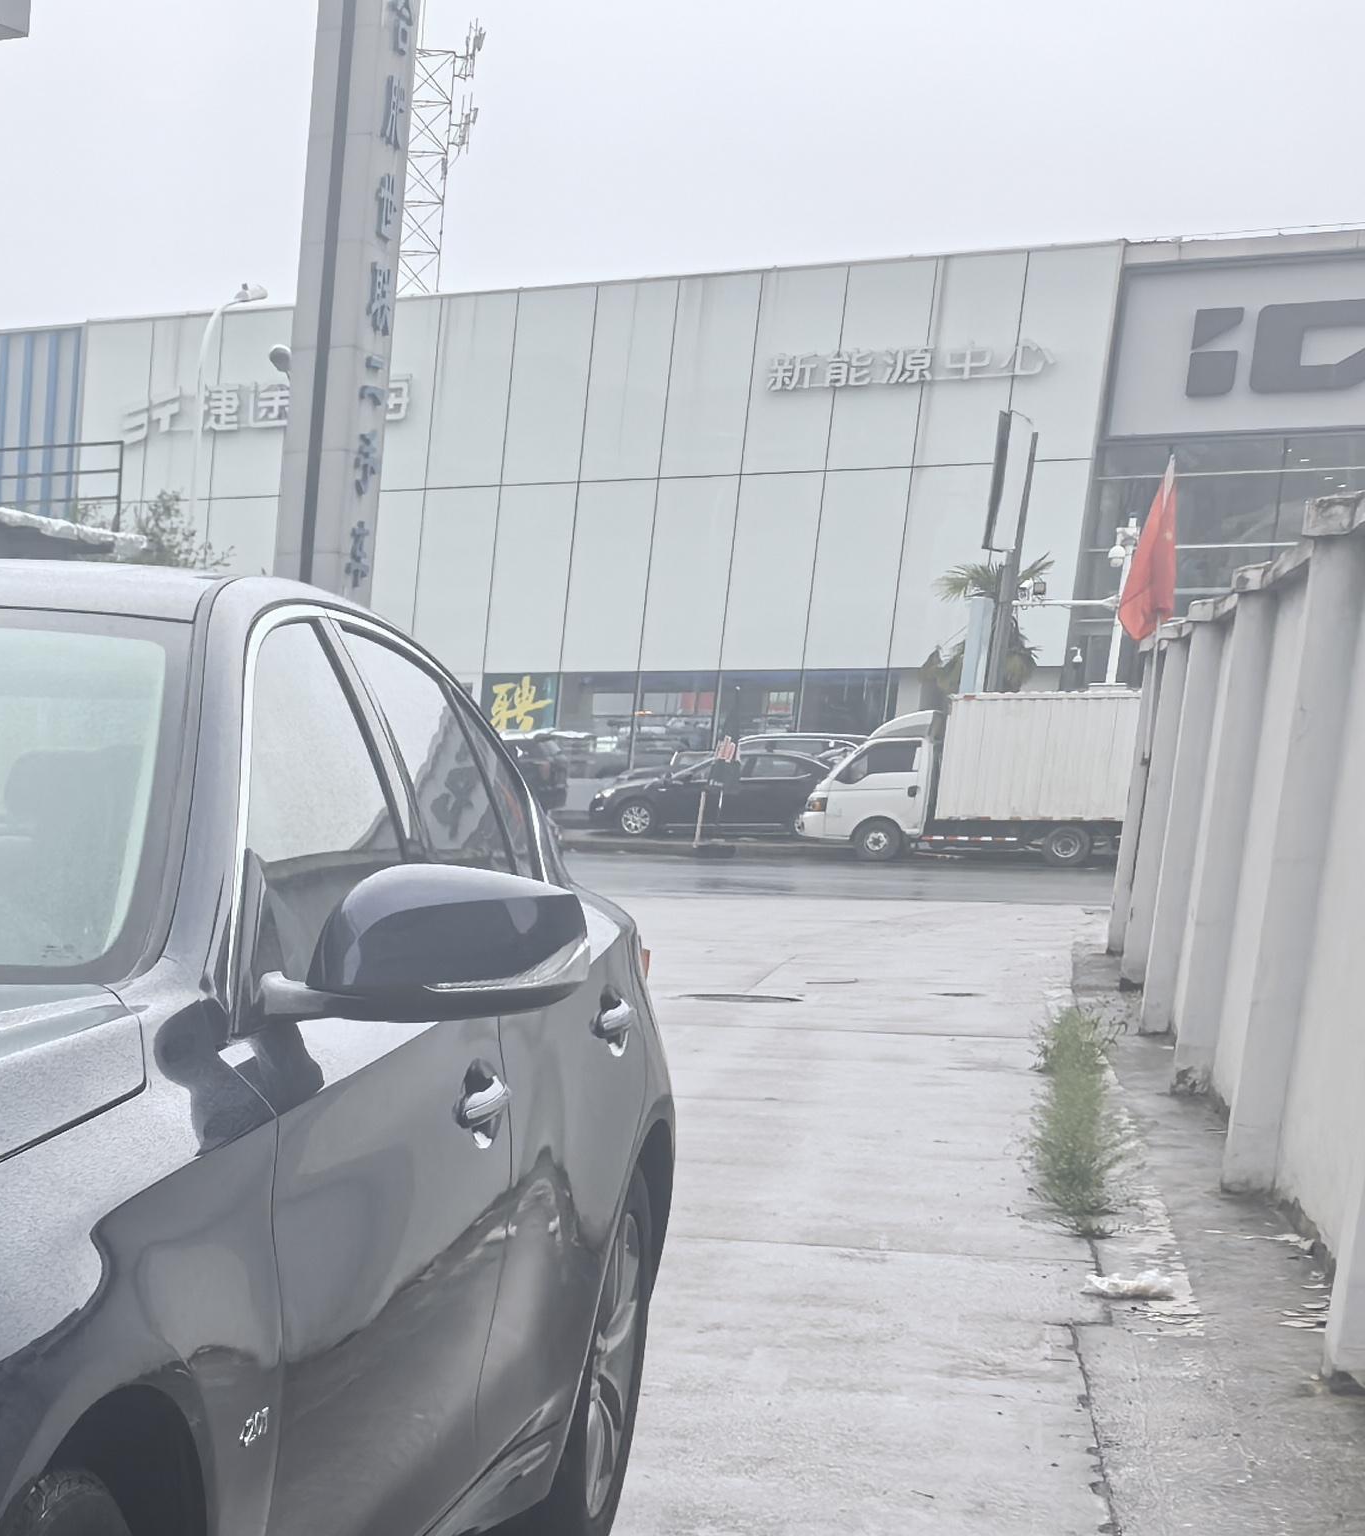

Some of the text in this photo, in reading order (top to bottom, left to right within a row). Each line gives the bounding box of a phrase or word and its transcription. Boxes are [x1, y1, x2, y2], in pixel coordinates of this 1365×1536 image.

[767, 338, 1056, 392] 新能源中心
